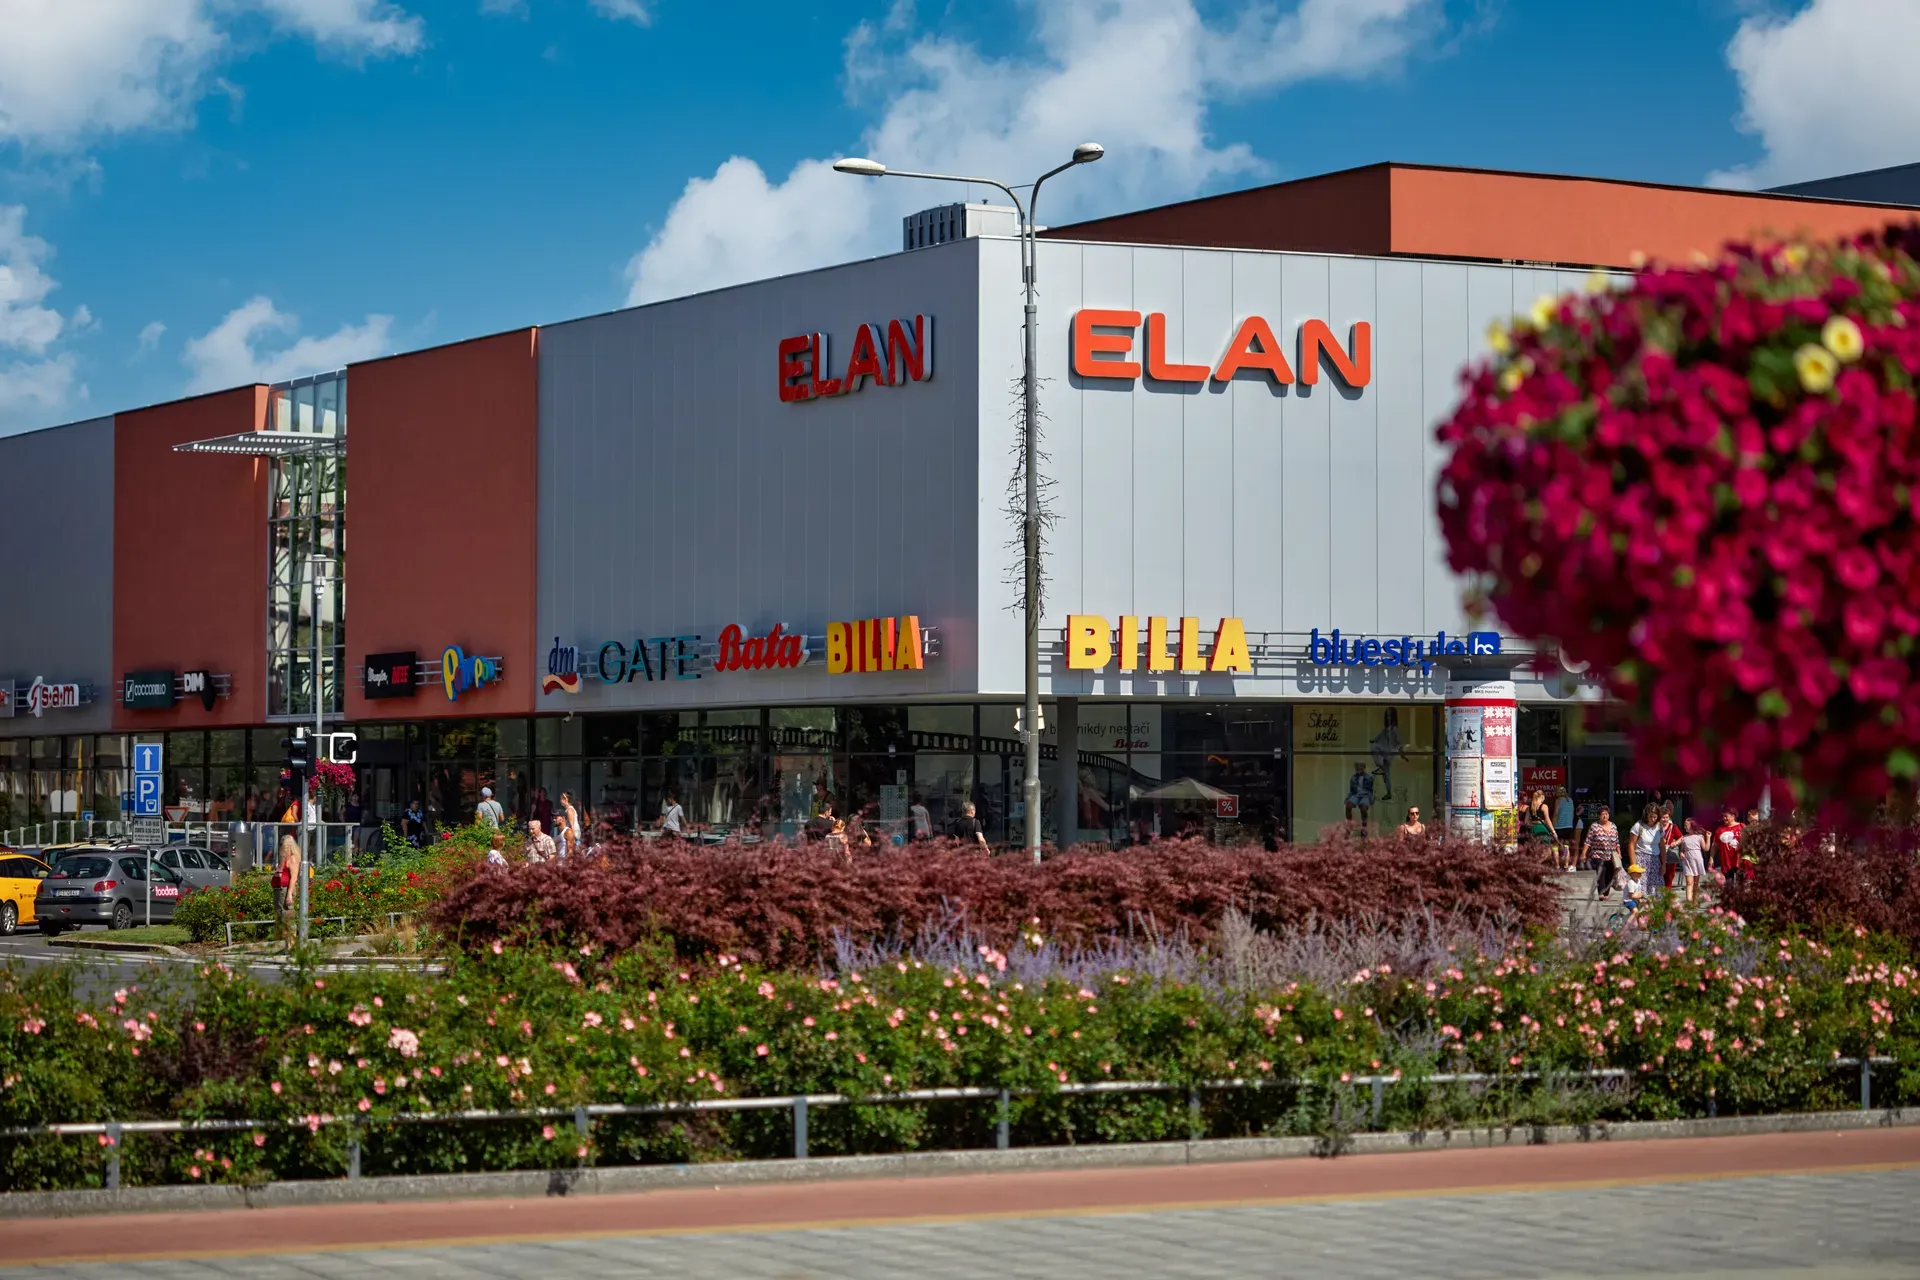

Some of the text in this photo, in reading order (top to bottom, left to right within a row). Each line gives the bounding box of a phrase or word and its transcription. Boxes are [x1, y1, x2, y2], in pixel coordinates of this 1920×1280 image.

[779, 313, 931, 402] ELAN
[1073, 308, 1371, 387] ELAN
[548, 636, 578, 673] dm
[598, 635, 702, 684] GATE
[827, 615, 924, 674] BILLA
[1065, 615, 1252, 671] BILLA
[1077, 723, 1107, 738] nikdy
[140, 780, 155, 803] P
[1531, 770, 1557, 780] AKCE
[154, 885, 178, 897] foodora
